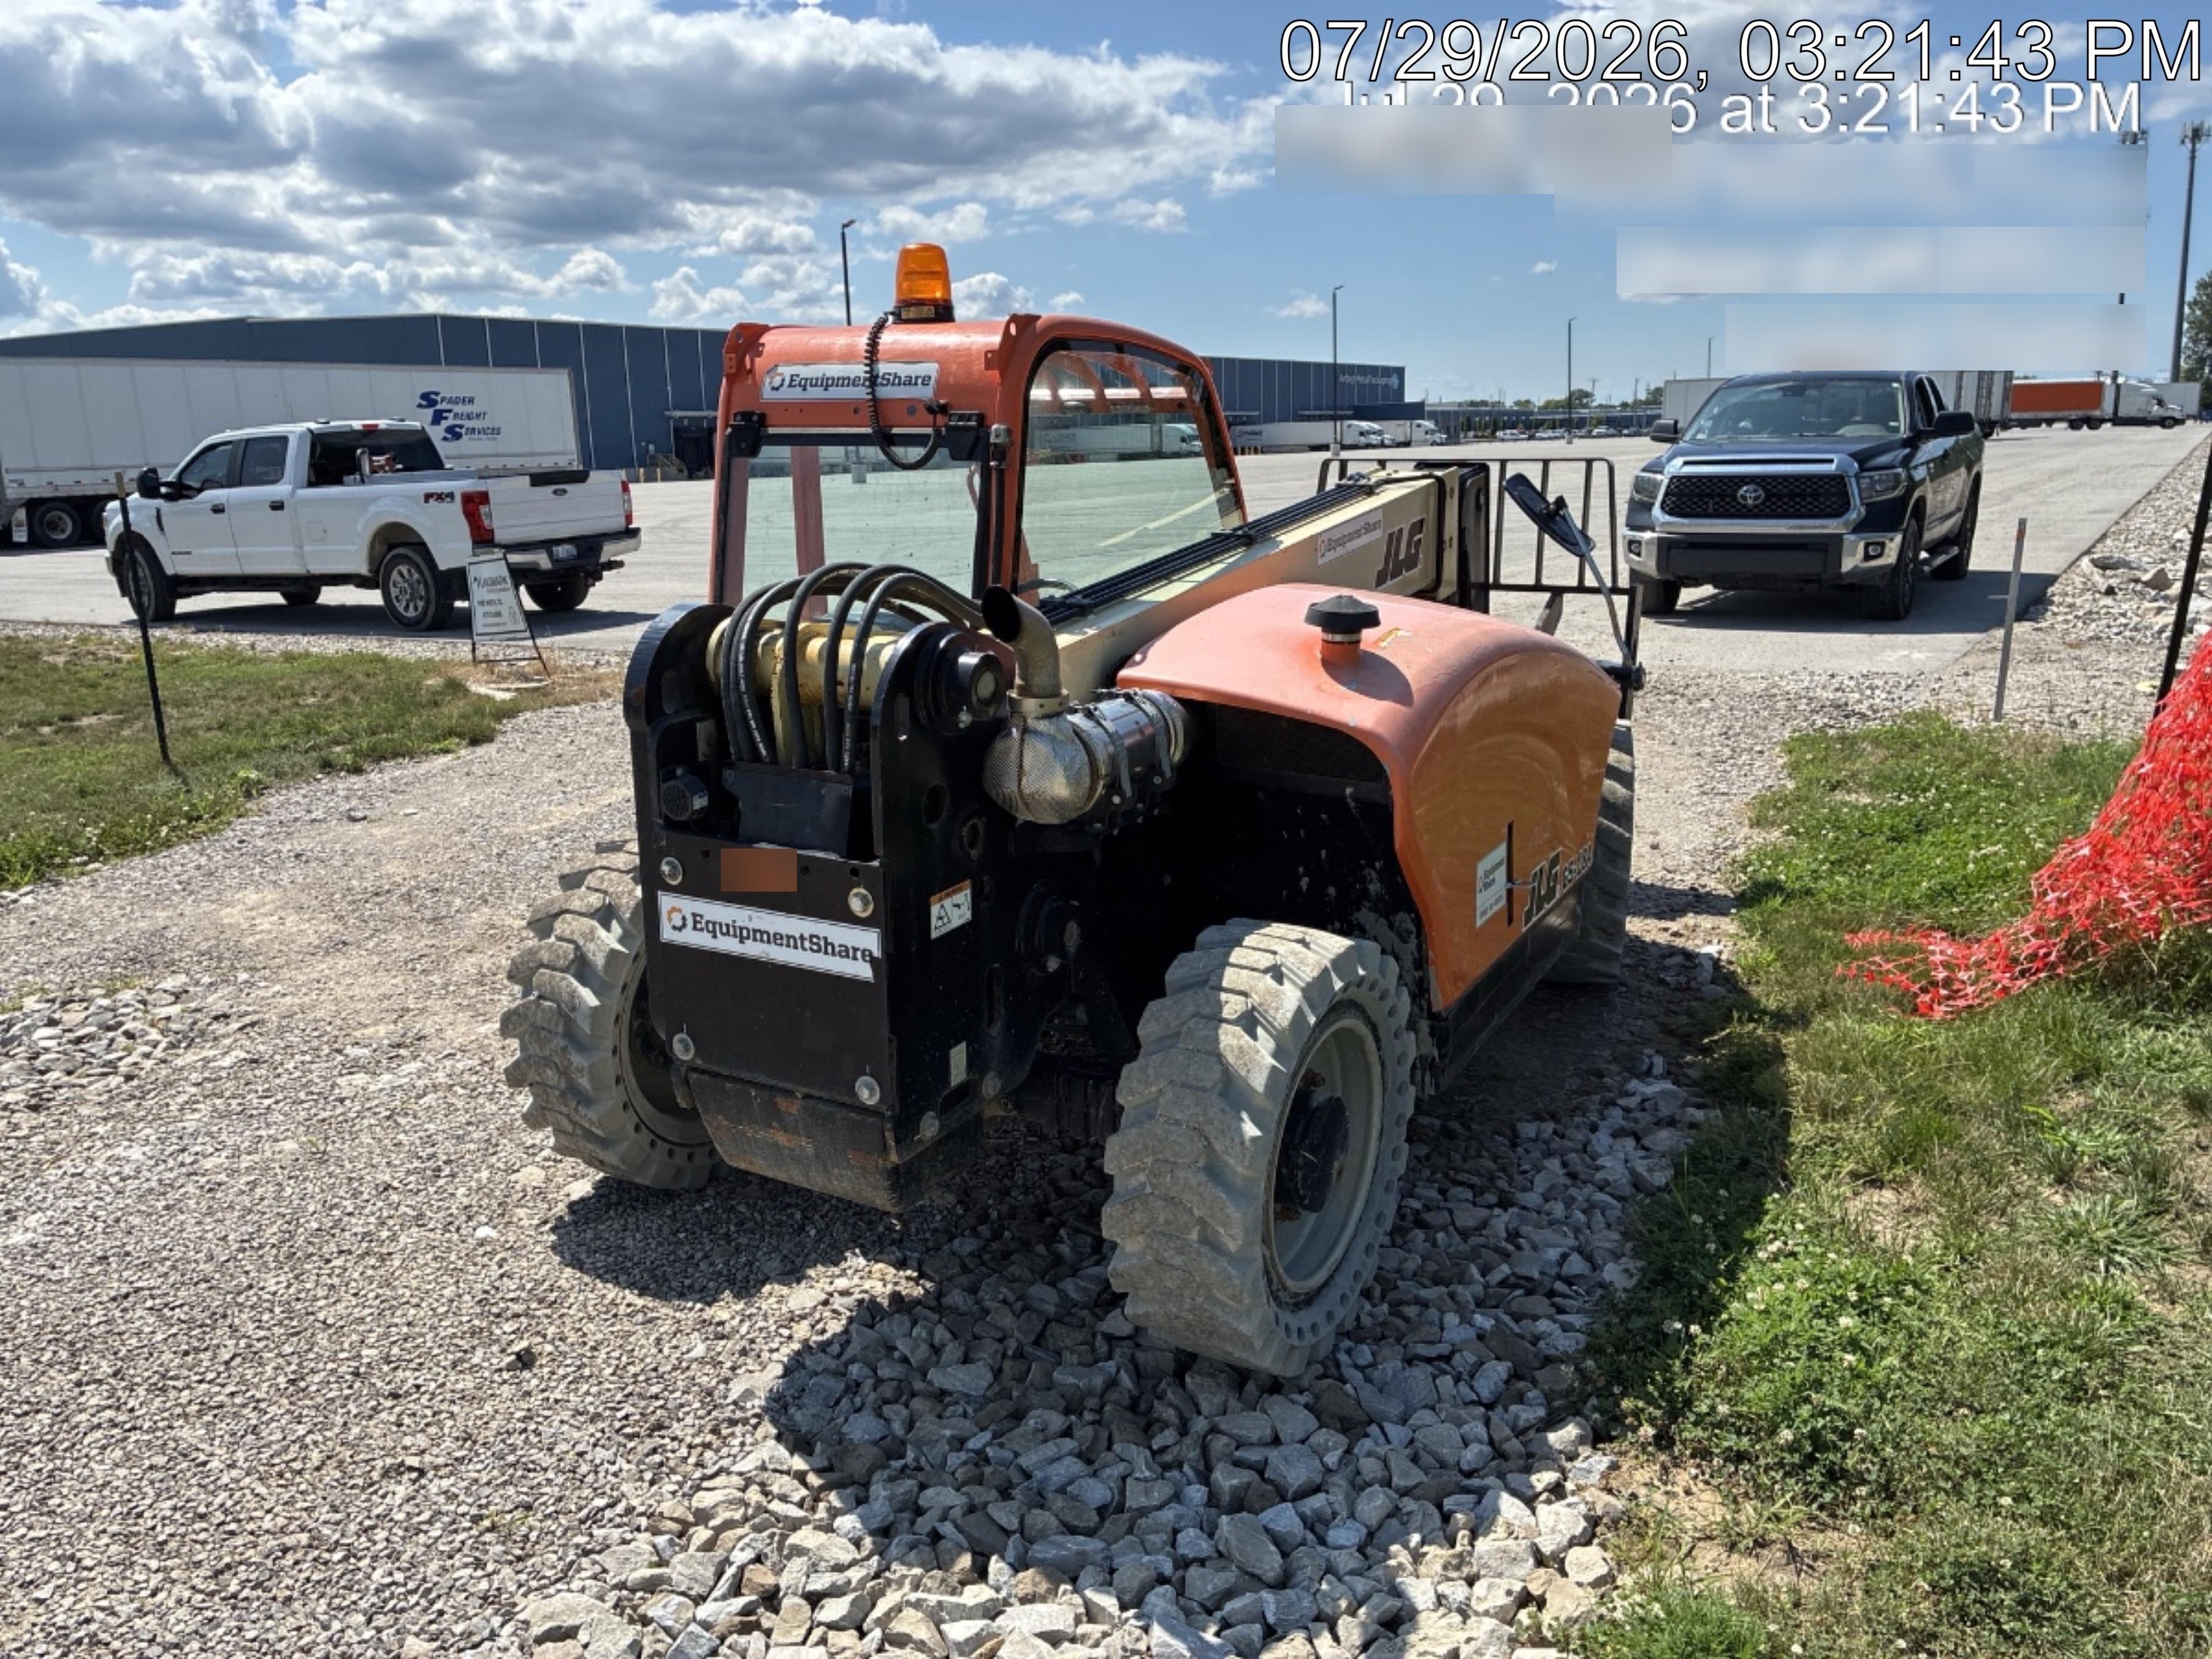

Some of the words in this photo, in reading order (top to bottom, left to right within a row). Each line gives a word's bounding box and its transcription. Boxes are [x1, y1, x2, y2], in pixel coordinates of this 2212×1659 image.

[1375, 516, 1426, 589] JLG
[1523, 847, 1561, 931] JLG
[691, 912, 874, 963] EquipmentShare
